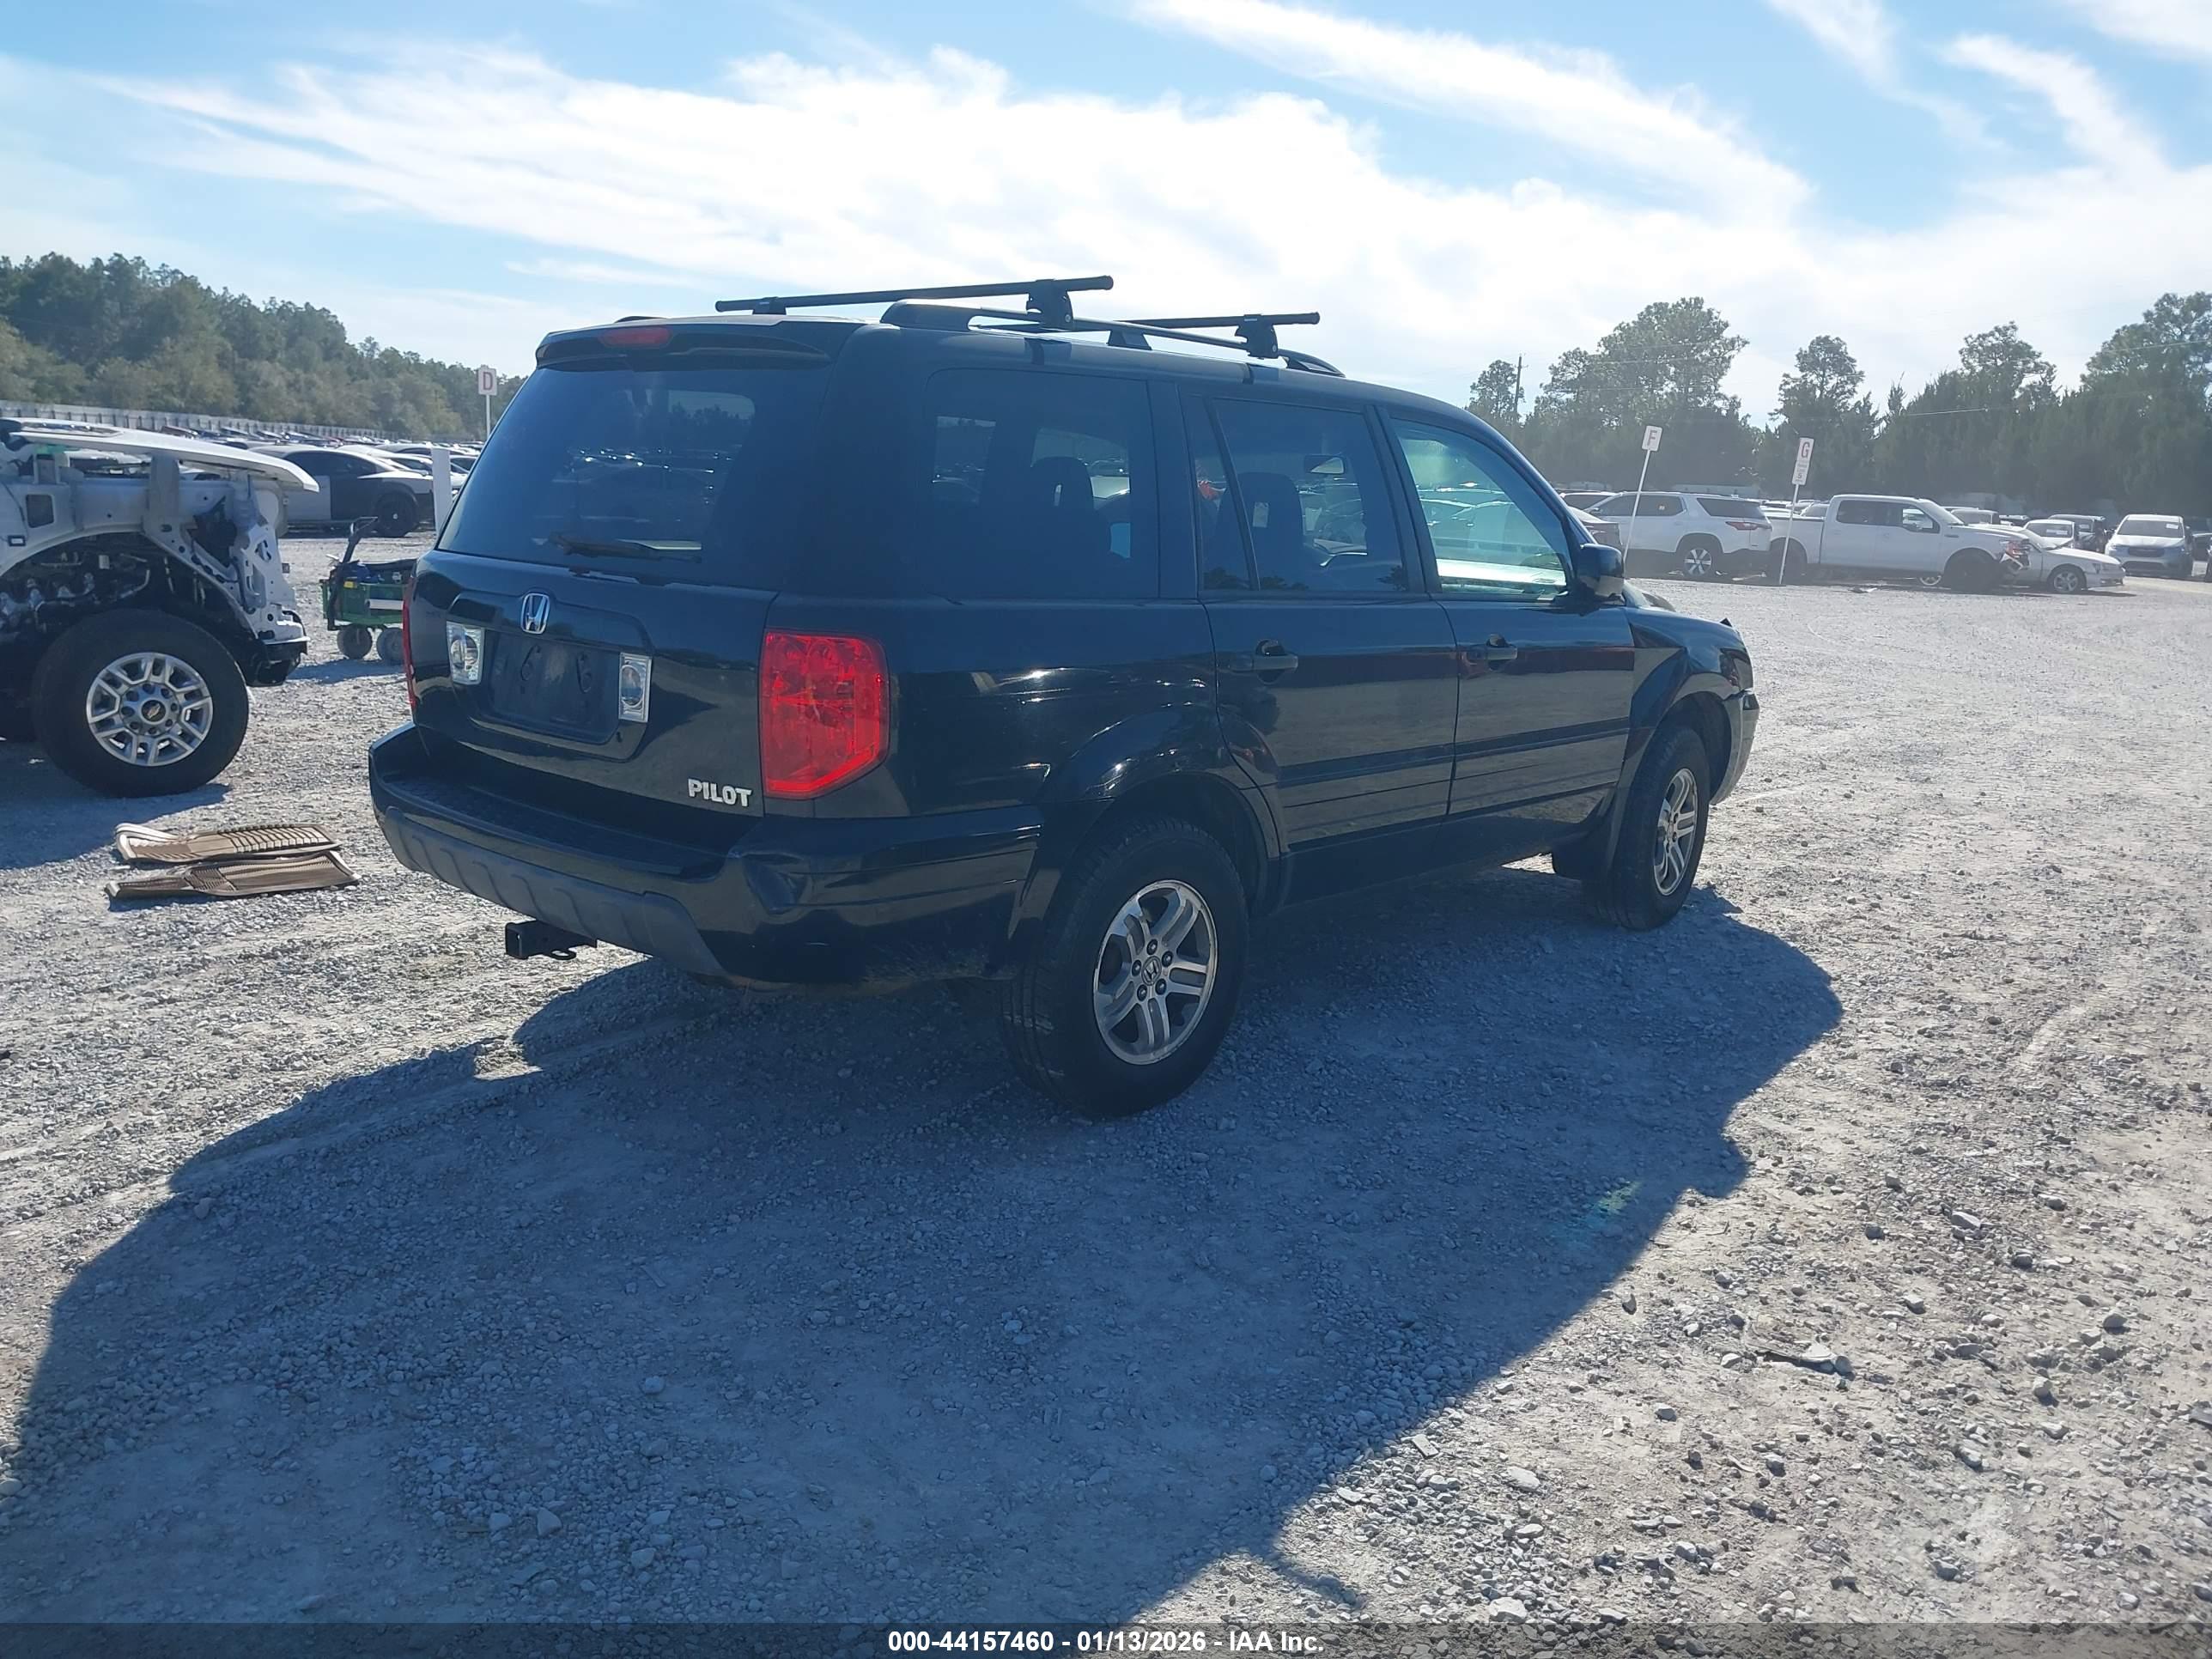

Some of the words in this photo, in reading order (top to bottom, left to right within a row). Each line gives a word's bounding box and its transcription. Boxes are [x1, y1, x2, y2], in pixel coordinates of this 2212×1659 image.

[483, 371, 493, 391] D
[1647, 429, 1657, 447] F
[1801, 441, 1810, 458] G
[688, 778, 752, 807] PILOT
